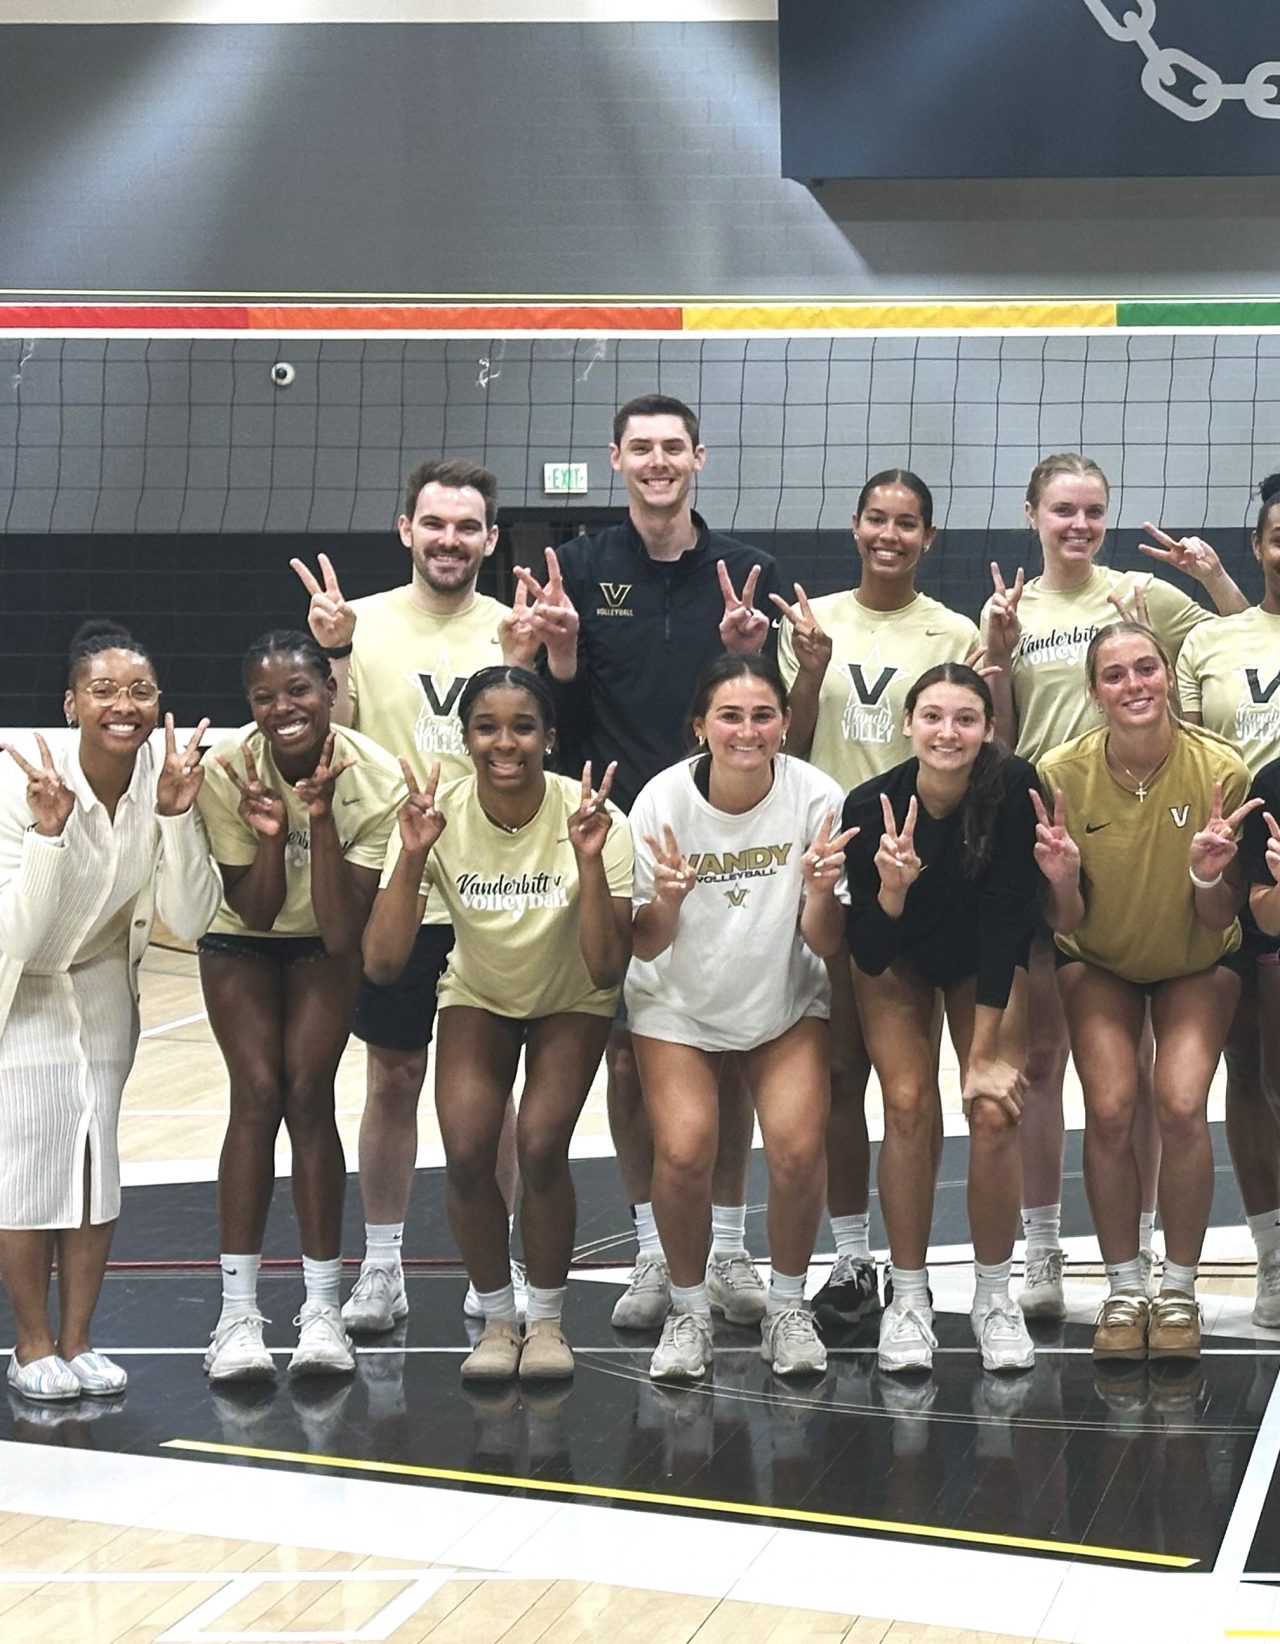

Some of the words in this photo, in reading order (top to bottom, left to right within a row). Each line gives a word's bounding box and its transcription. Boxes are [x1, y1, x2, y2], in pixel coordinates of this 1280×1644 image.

[552, 469, 580, 489] EXIT
[599, 583, 632, 607] V
[417, 673, 469, 717] V
[847, 663, 898, 706] V
[1168, 804, 1191, 828] V
[456, 872, 552, 895] Vanderbilt
